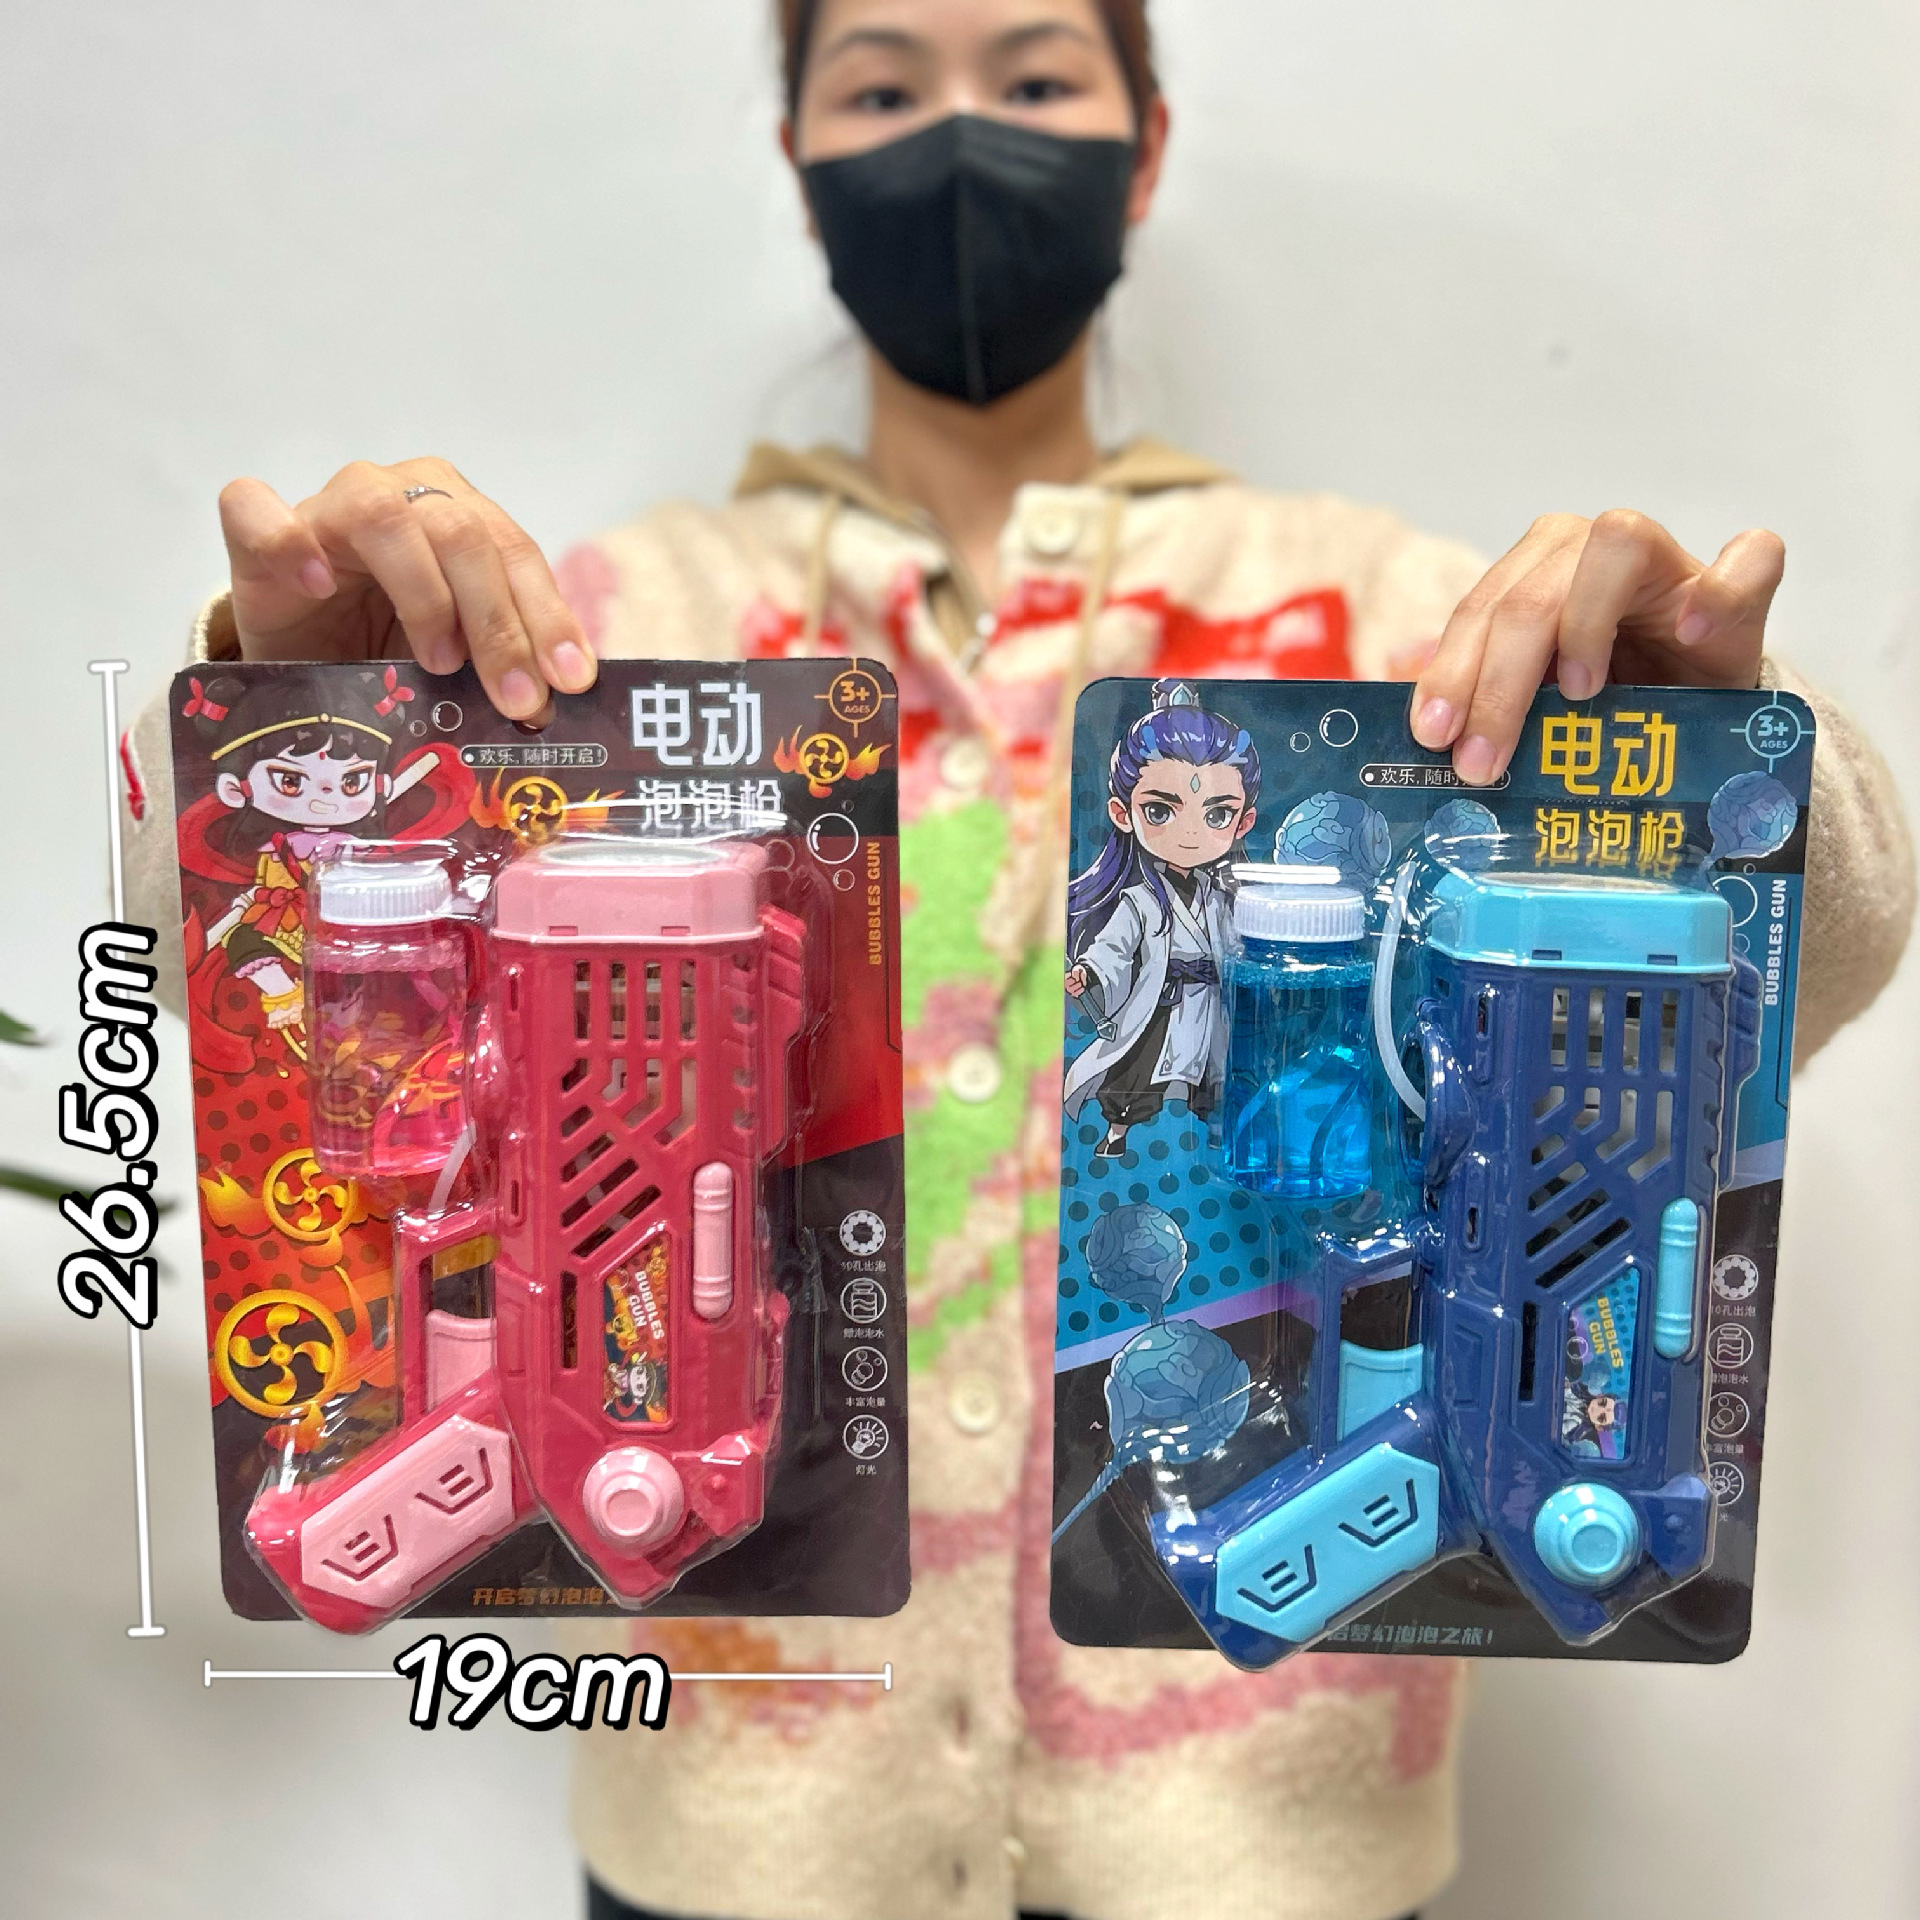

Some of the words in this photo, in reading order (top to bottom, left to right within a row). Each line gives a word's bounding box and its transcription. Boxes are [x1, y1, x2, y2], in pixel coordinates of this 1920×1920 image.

[841, 681, 870, 702] 3+
[844, 705, 871, 714] AGES
[632, 683, 762, 766] 电动
[1758, 715, 1789, 737] 3+
[1540, 711, 1677, 797] 电动
[1760, 740, 1788, 749] AGES
[1380, 767, 1506, 786] 欢乐,随时!
[639, 779, 784, 831] 泡泡枪
[1535, 808, 1685, 868] 泡泡枪
[867, 842, 881, 880] GUN
[1770, 879, 1787, 918] GUN
[867, 885, 882, 965] BUBBLES
[1764, 923, 1784, 1006] BUBBLES
[629, 1295, 647, 1327] GUN
[635, 1271, 665, 1340] BUBBLES
[1589, 1321, 1606, 1355] GUN
[1598, 1297, 1625, 1369] BUBBLES
